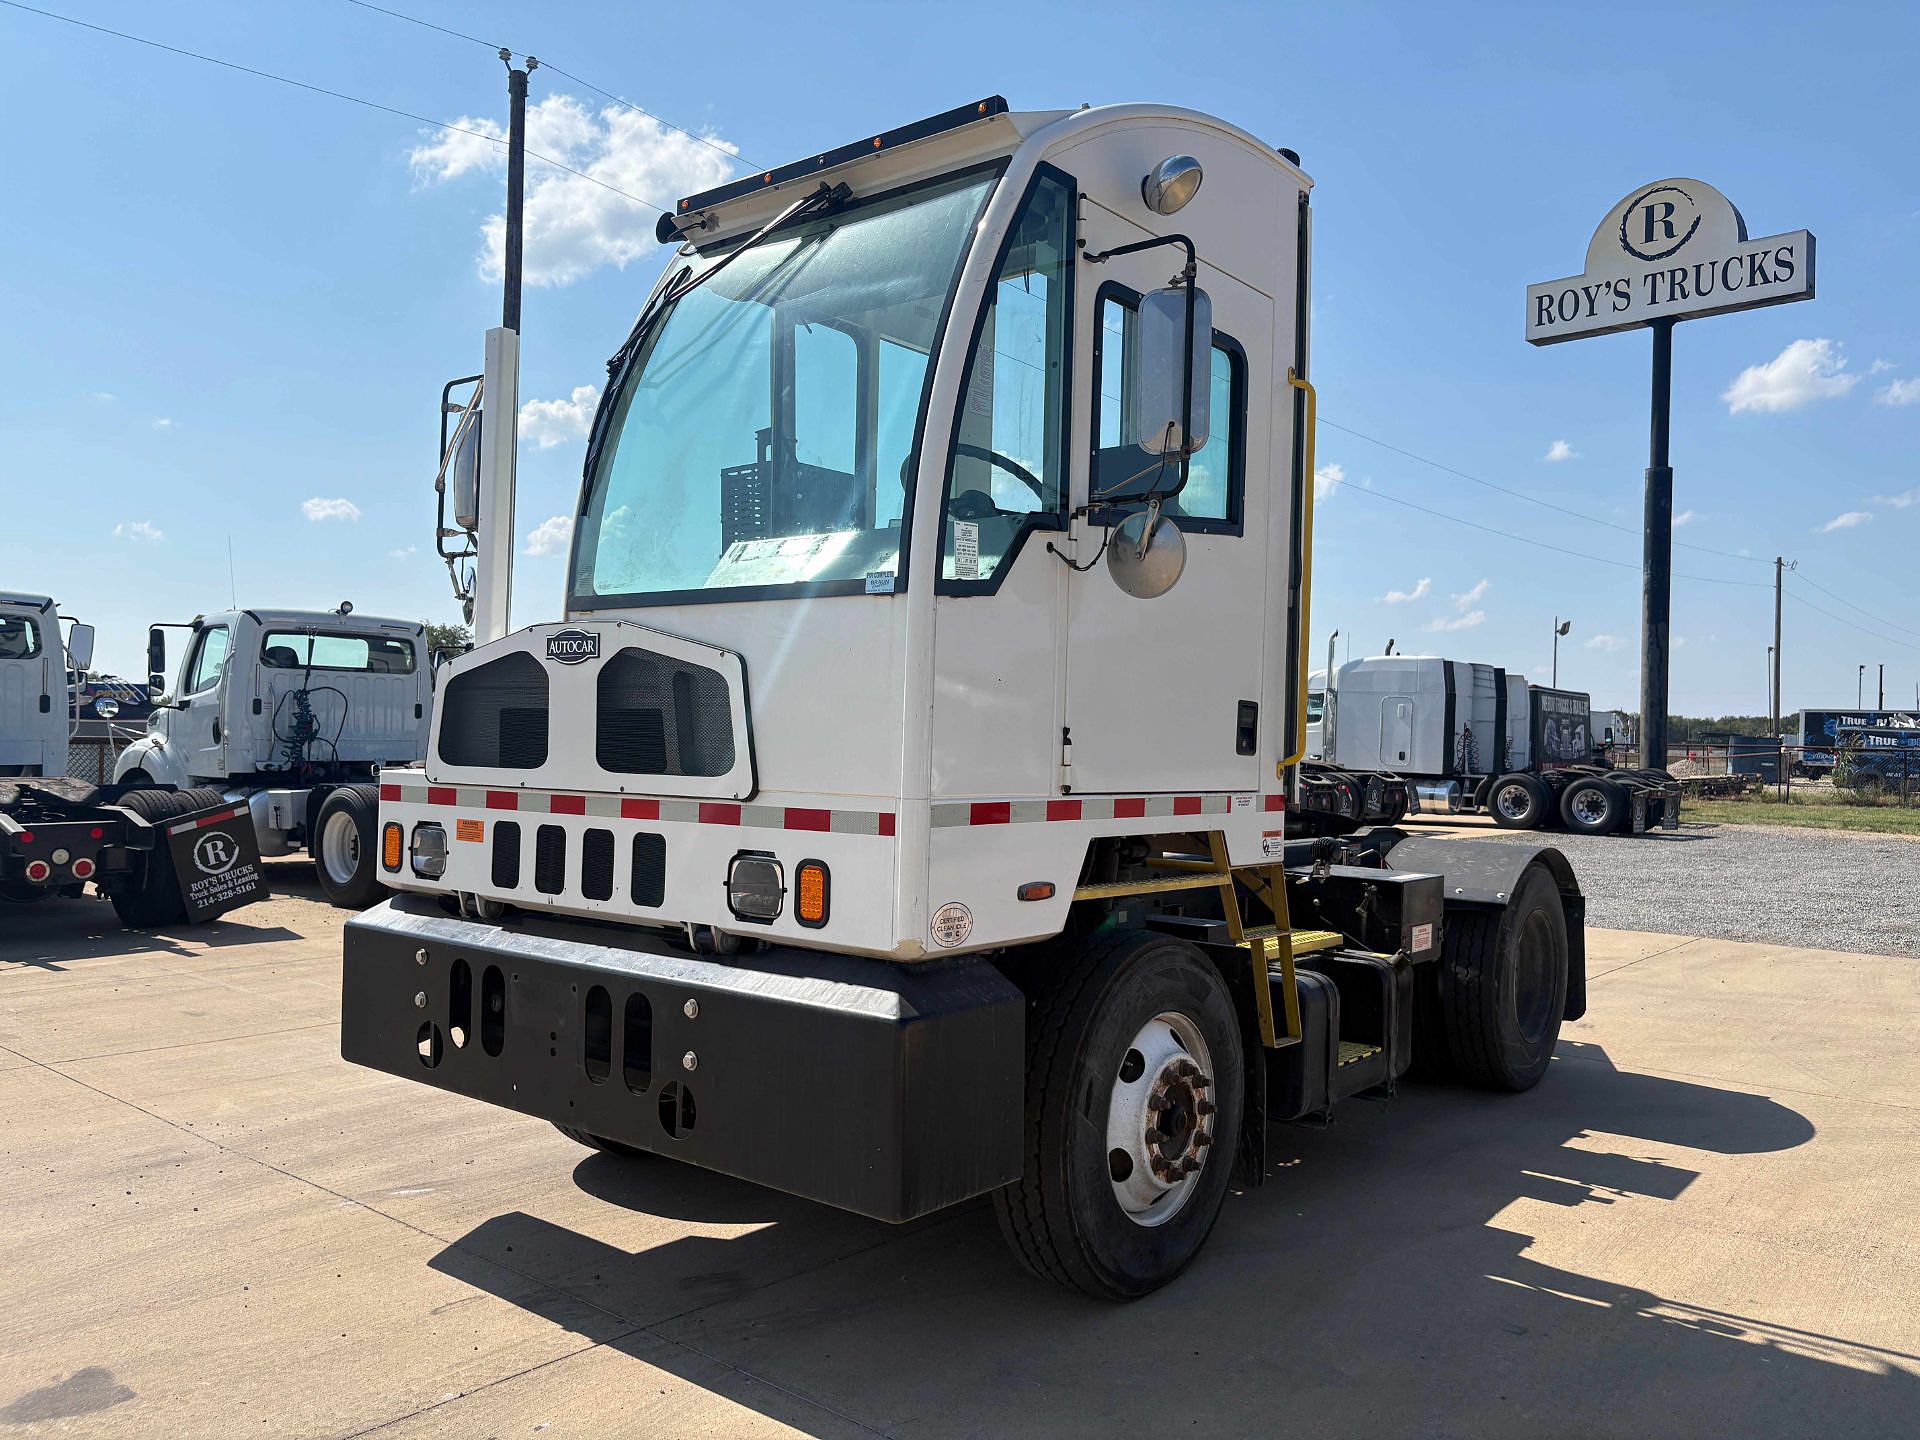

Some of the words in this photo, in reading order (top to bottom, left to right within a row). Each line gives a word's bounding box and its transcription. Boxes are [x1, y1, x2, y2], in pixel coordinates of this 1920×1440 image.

[1640, 202, 1678, 244] R
[1535, 278, 1630, 326] ROY'S
[1644, 247, 1794, 305] TRUCKS
[549, 641, 594, 653] AUTOCAR
[1841, 716, 1867, 725] TRUE
[1869, 735, 1898, 746] TRUE
[203, 840, 229, 866] R
[190, 888, 209, 900] Truck
[209, 881, 227, 894] Sales
[227, 879, 234, 887] &
[234, 872, 259, 886] Leasing
[191, 876, 217, 892] ROY'S
[219, 864, 254, 883] TRUCKS
[197, 882, 256, 908] 214-328-5161
